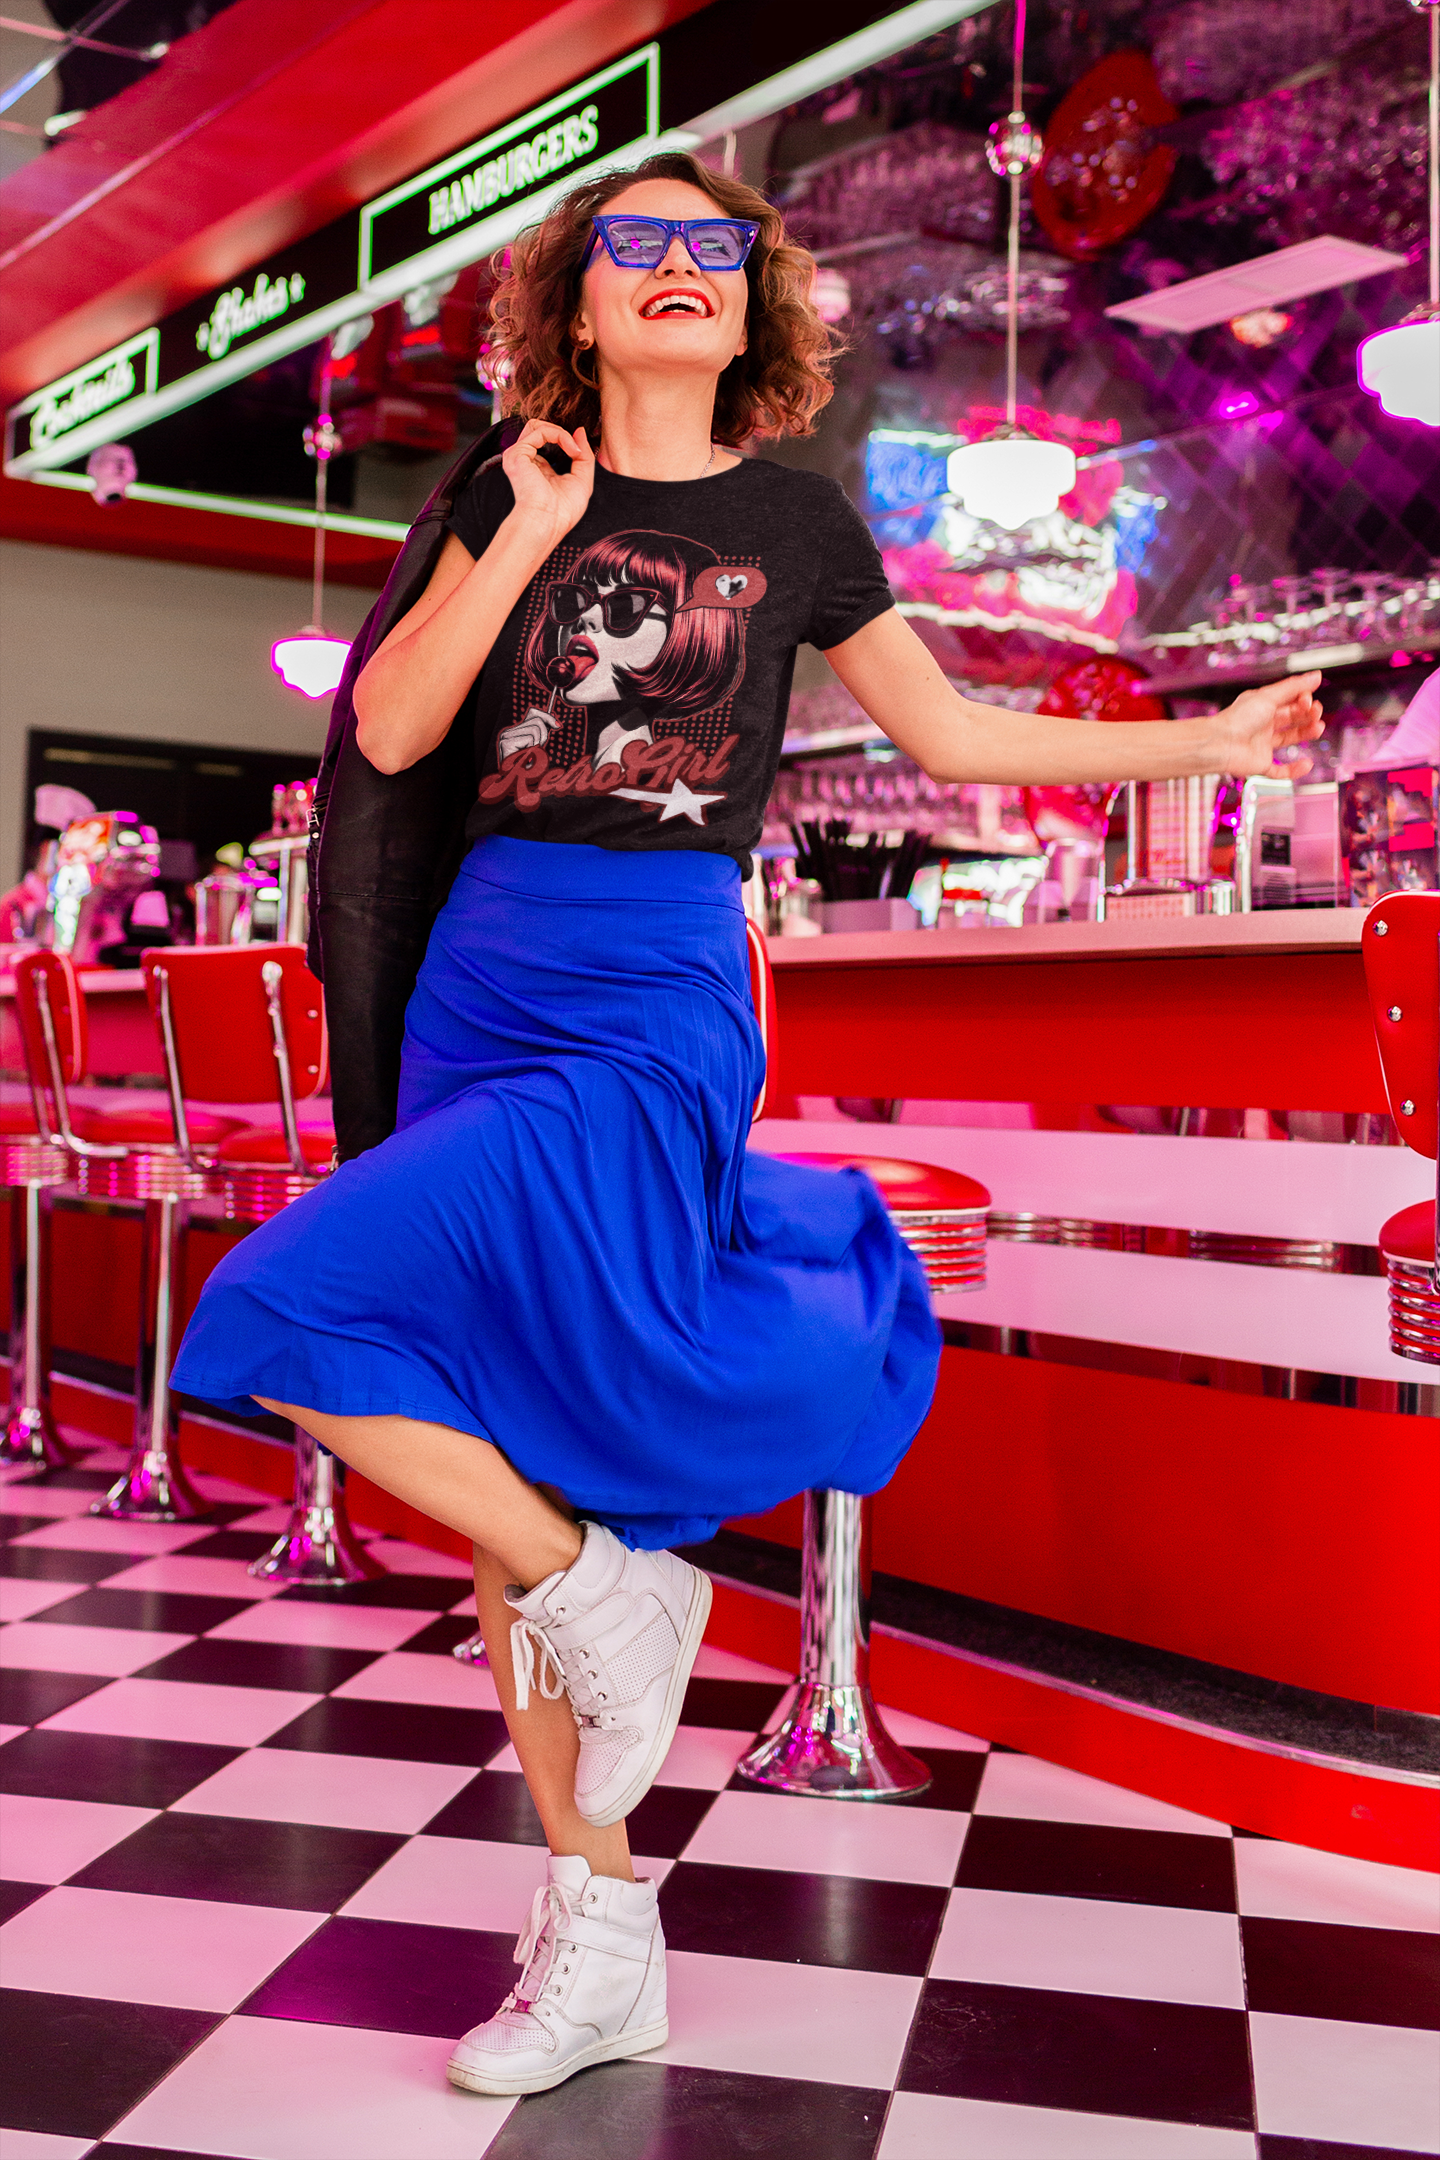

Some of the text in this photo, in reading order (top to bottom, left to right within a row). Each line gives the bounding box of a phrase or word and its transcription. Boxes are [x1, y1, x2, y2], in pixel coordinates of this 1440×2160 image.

[428, 104, 599, 235] HAMBURGERS
[478, 732, 741, 812] Retro Girl
